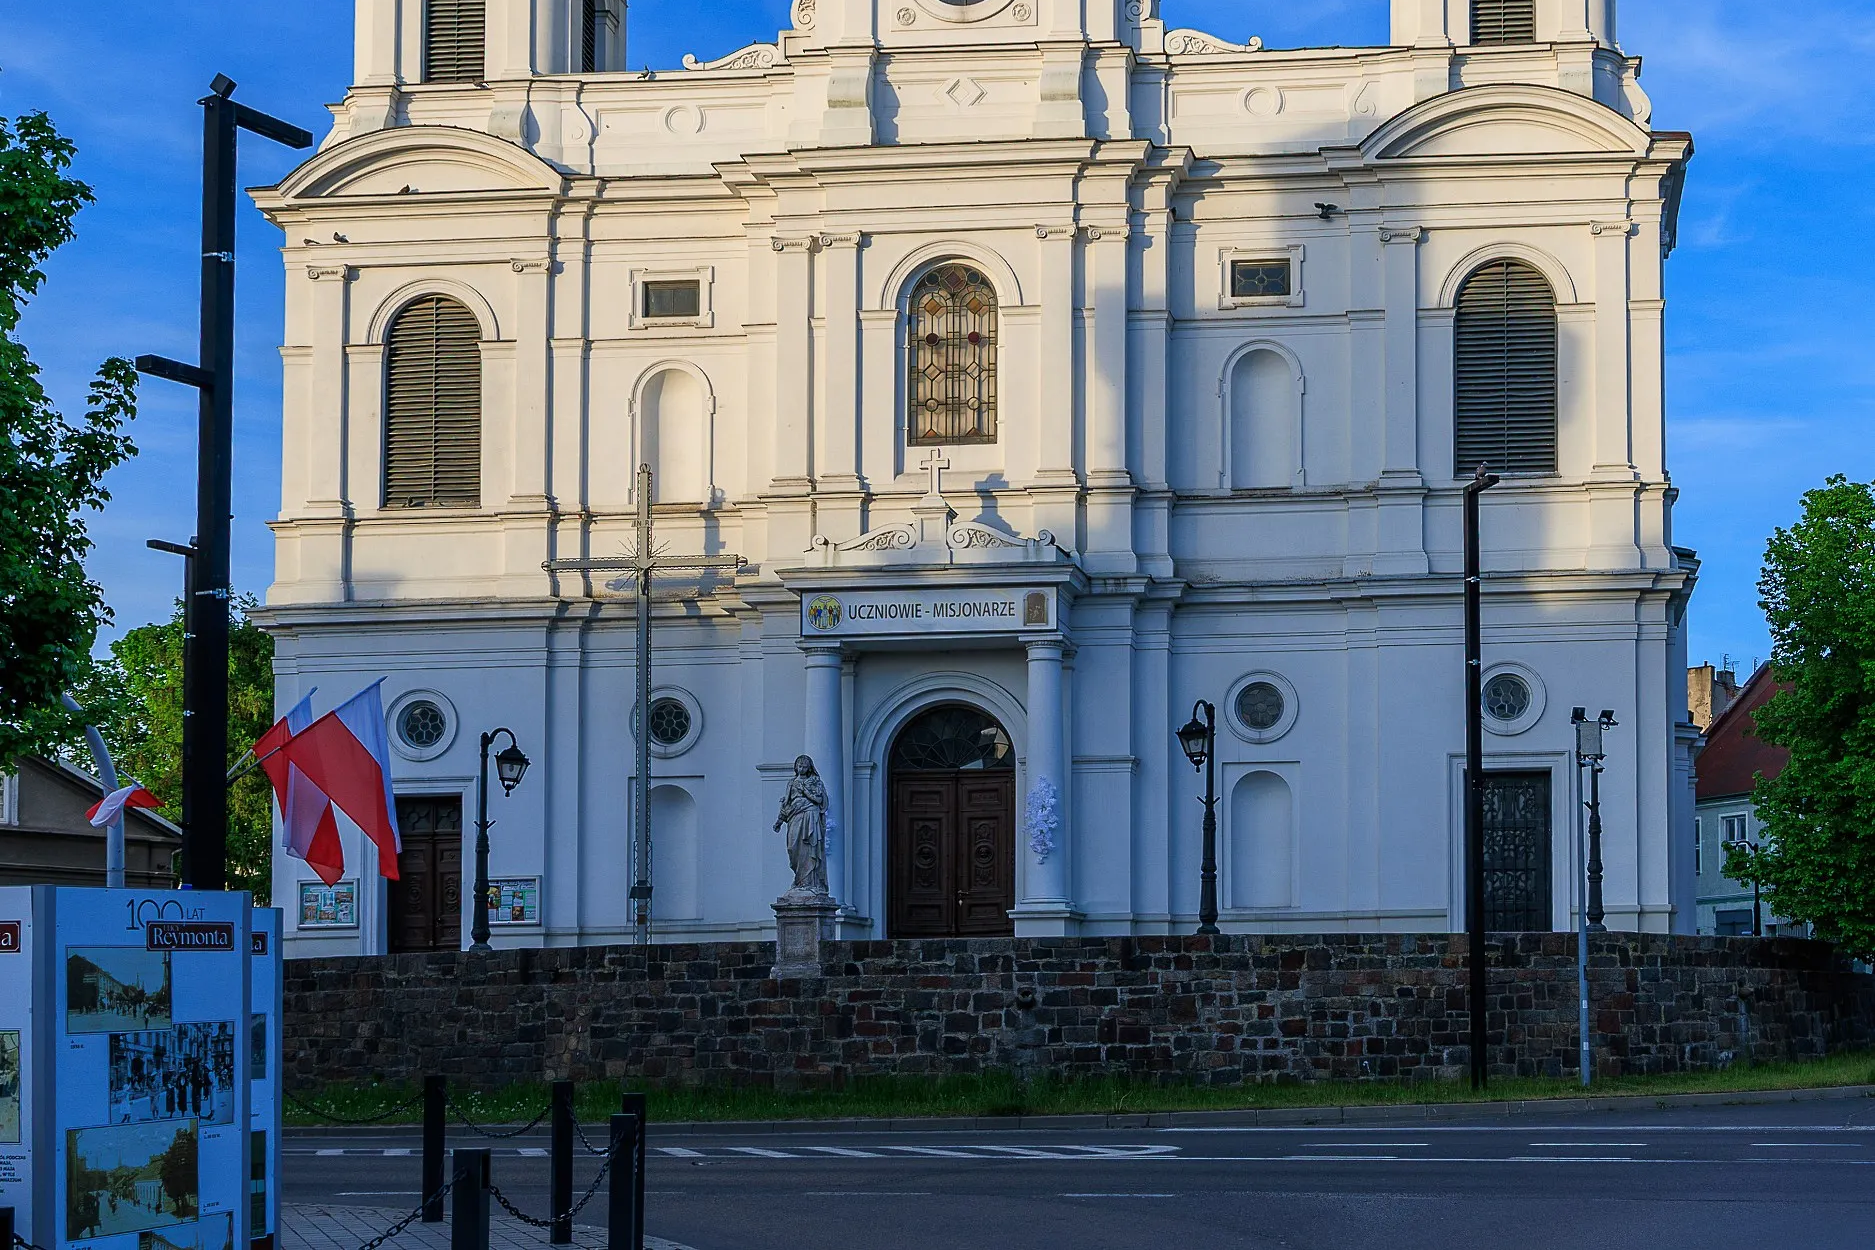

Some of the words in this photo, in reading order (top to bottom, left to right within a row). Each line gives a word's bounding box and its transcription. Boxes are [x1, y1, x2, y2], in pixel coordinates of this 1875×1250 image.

[848, 603, 922, 620] UCZNIOWIE
[933, 601, 1015, 618] MISJONARZE
[126, 899, 184, 930] 100
[186, 908, 205, 920] LAT
[153, 927, 228, 949] Reymonta
